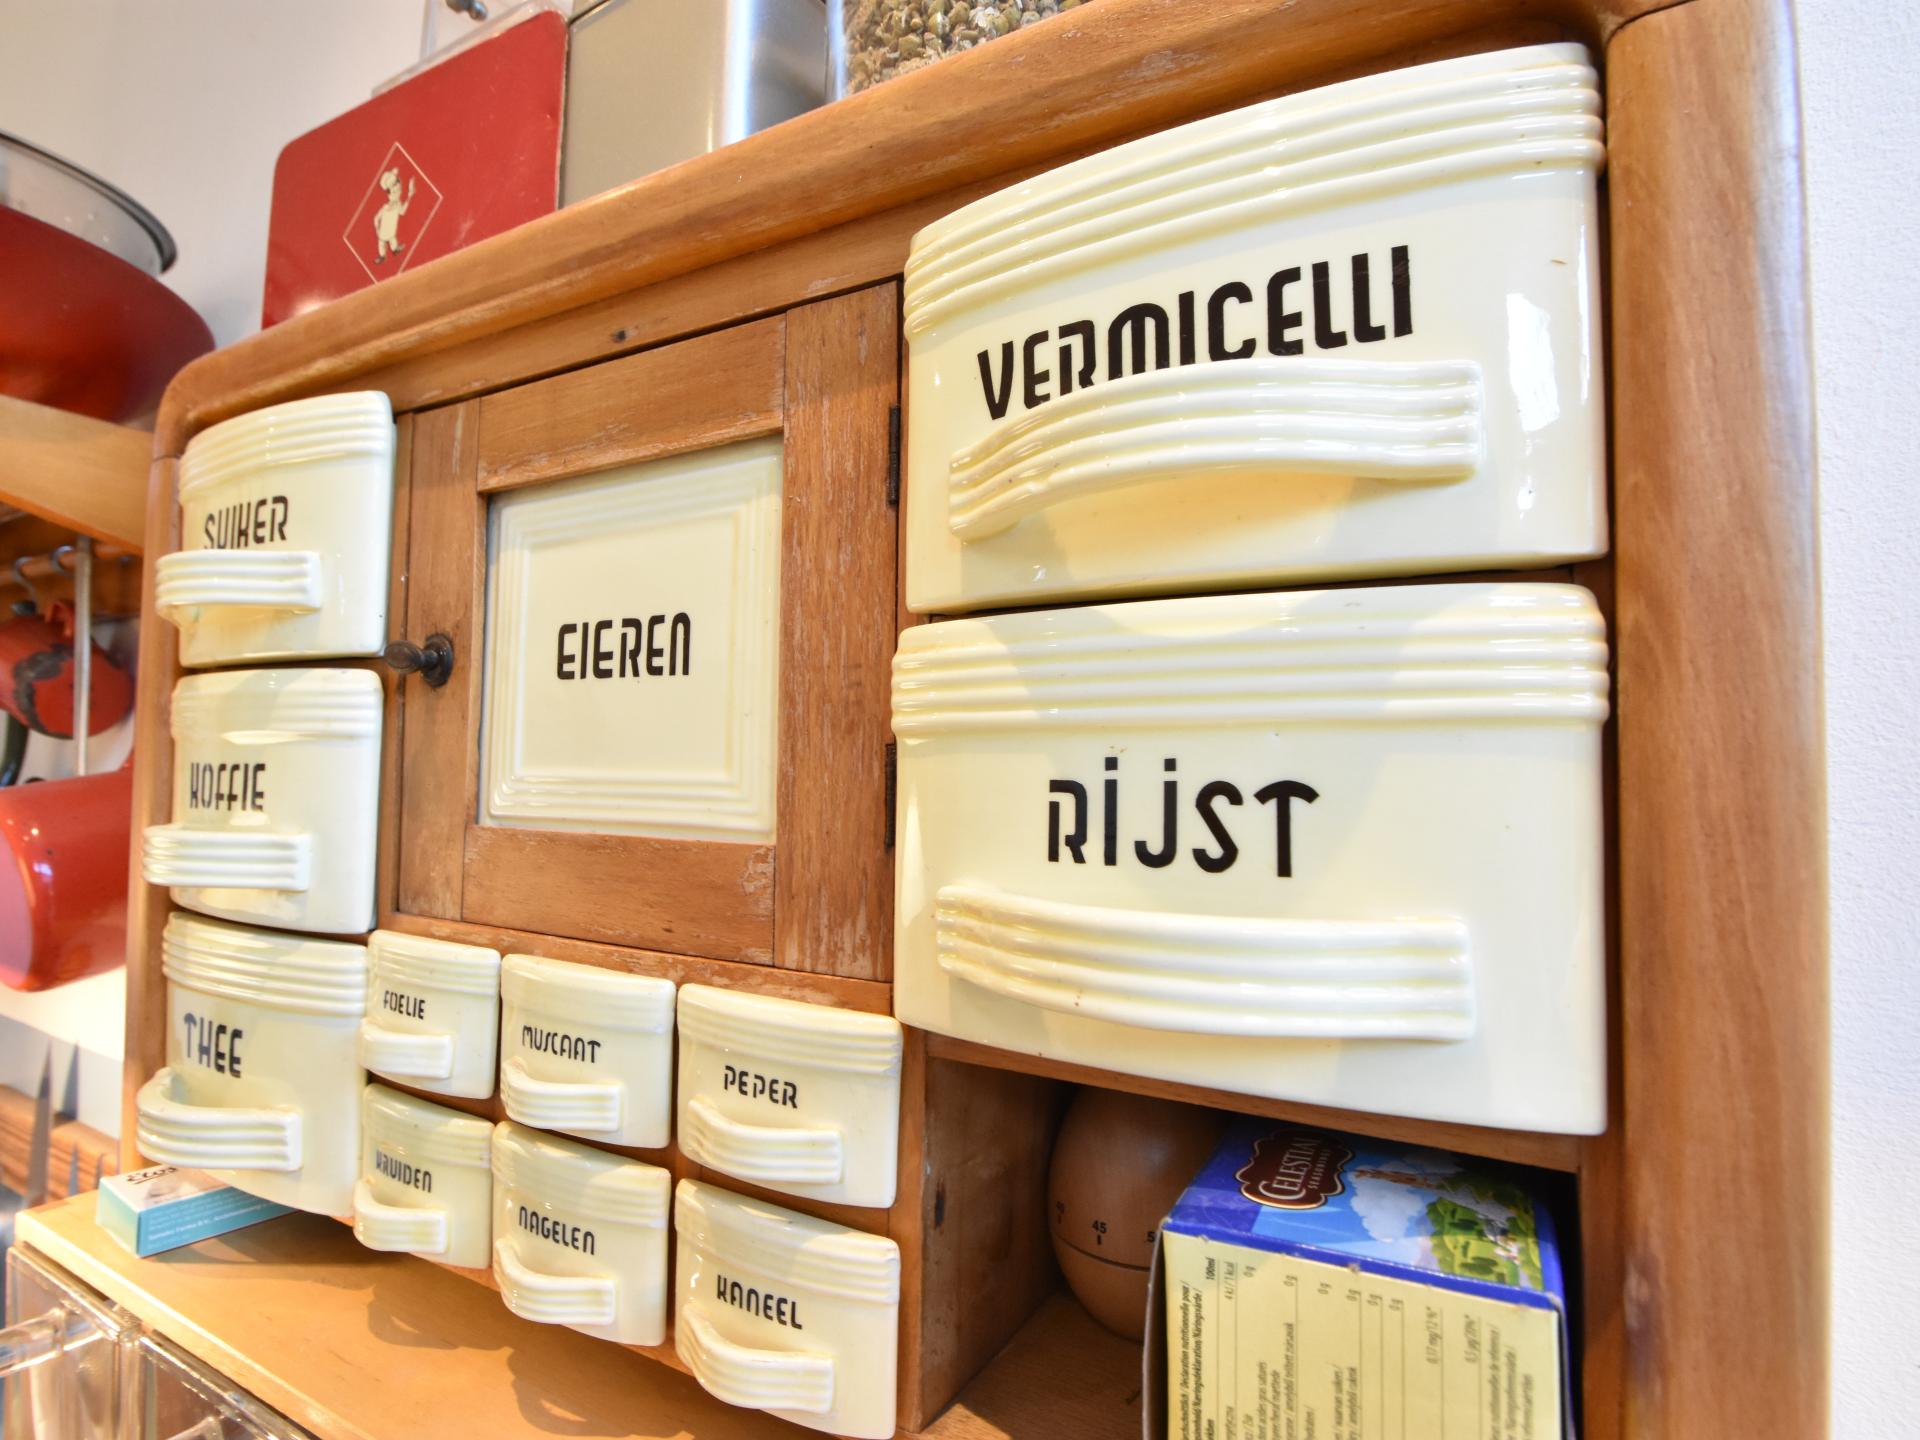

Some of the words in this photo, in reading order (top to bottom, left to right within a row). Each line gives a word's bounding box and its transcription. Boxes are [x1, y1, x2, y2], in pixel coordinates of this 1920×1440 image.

[977, 244, 1413, 421] VERMICELLI
[204, 495, 289, 550] SUIKER
[556, 612, 691, 680] EIEREN
[189, 762, 266, 812] KOFFIE
[383, 990, 426, 1021] FOELIE
[184, 1012, 244, 1078] THEE
[522, 1025, 601, 1065] MUSCAAT
[724, 1065, 798, 1109] PEPER
[376, 1150, 432, 1193] KRUIDEN
[519, 1205, 596, 1256] NAGELEN
[1092, 1219, 1107, 1234] 45
[717, 1274, 803, 1330] KANEEL
